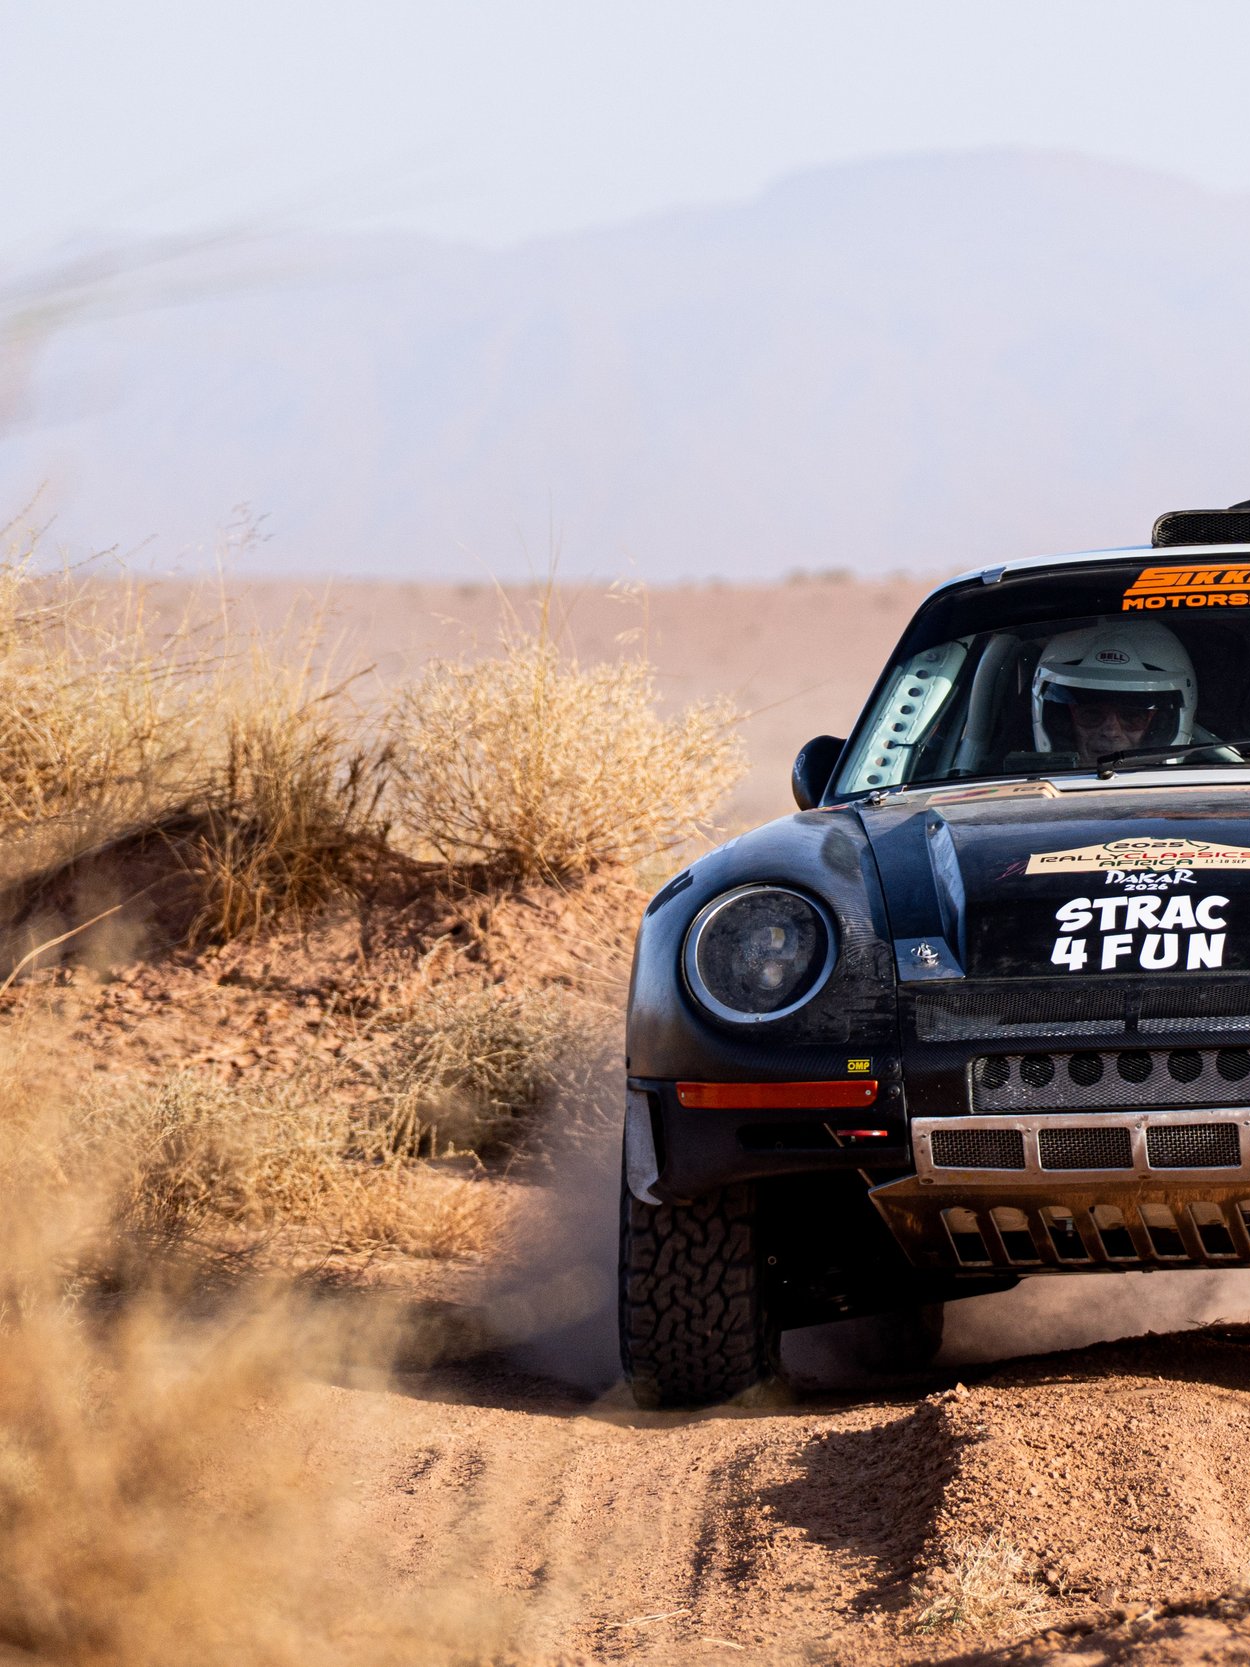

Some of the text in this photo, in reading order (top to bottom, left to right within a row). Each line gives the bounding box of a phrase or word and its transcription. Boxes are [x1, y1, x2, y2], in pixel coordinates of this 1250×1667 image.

[1100, 653, 1126, 661] BELL
[1099, 859, 1193, 867] AFRICA
[1105, 869, 1197, 884] DAKAR
[1124, 883, 1168, 891] 2026
[1055, 895, 1230, 932] STRAC
[1050, 933, 1226, 971] 4 FUN
[847, 1061, 870, 1070] OMP
